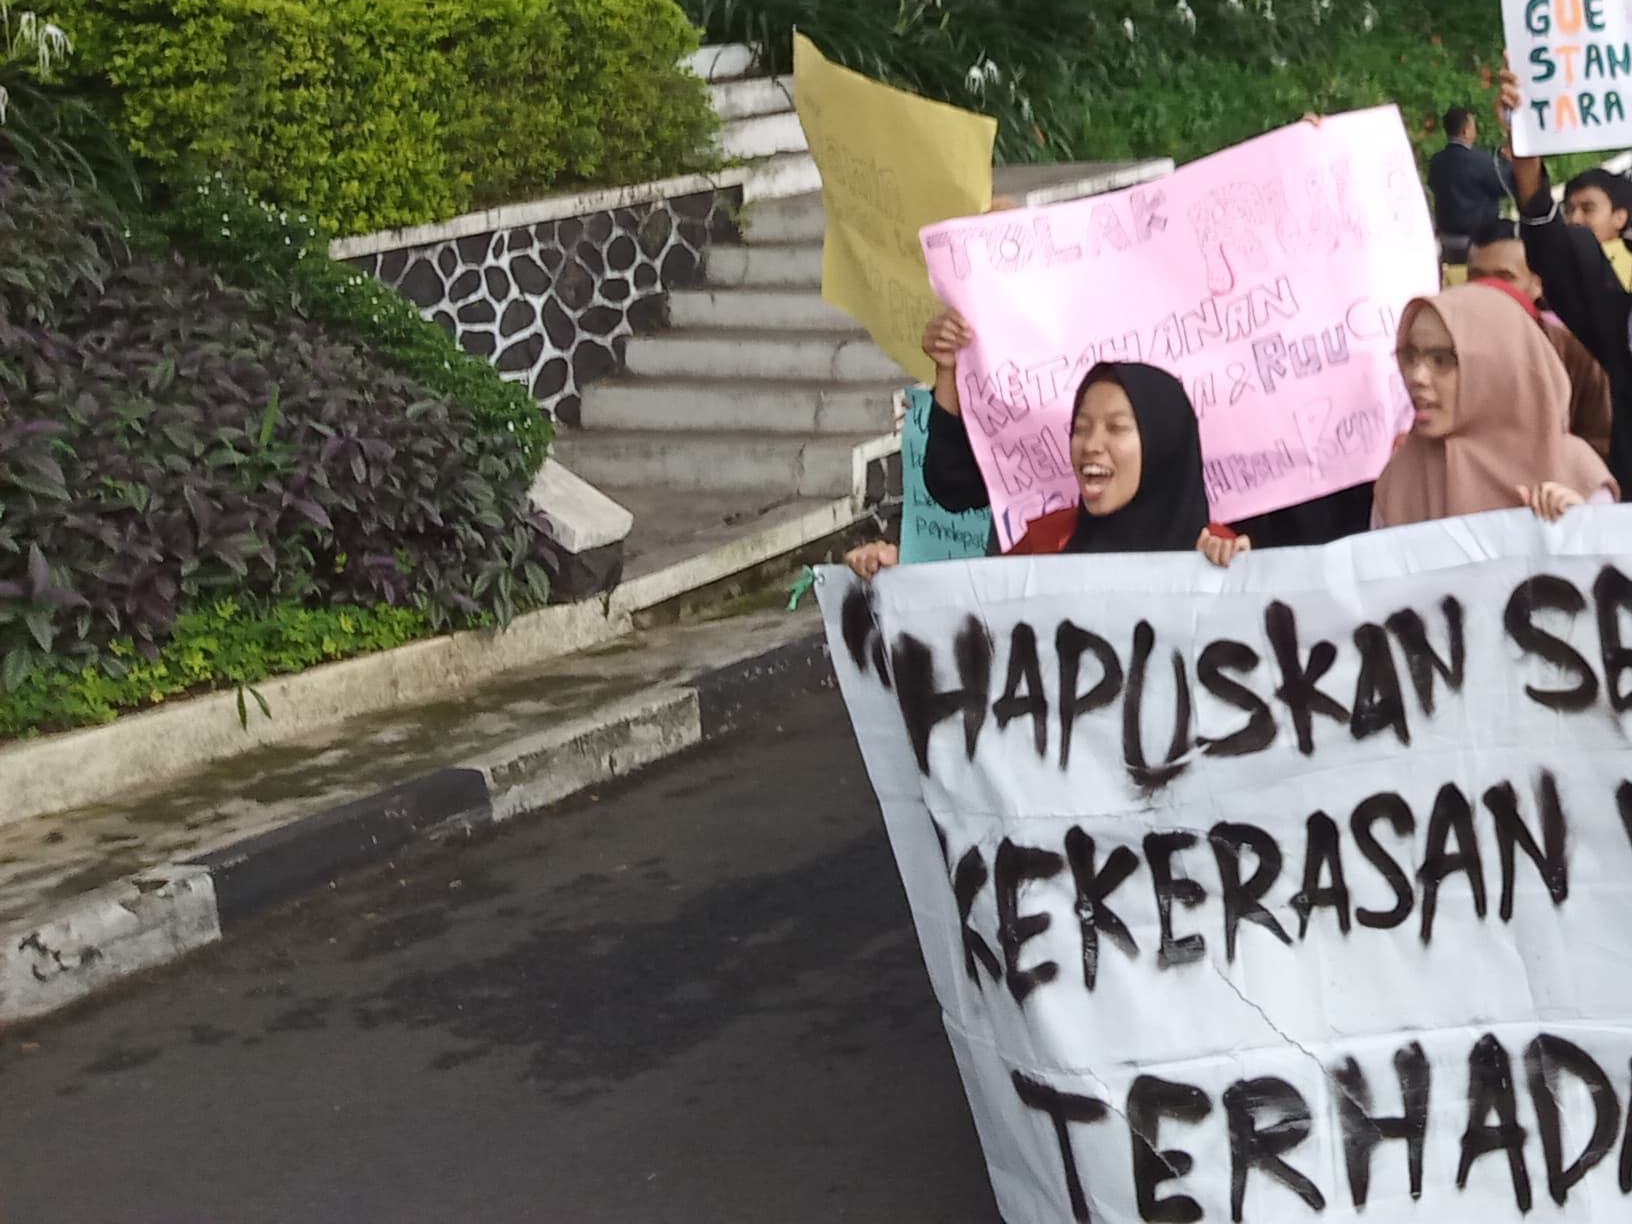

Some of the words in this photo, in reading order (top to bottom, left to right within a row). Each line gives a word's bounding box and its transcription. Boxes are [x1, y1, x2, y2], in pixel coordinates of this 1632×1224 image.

[1529, 41, 1632, 89] STAN
[1530, 91, 1626, 132] TARA
[925, 187, 1169, 282] TOLAK
[1250, 322, 1351, 396] RUU
[938, 771, 1573, 1003] KEKERASAN
